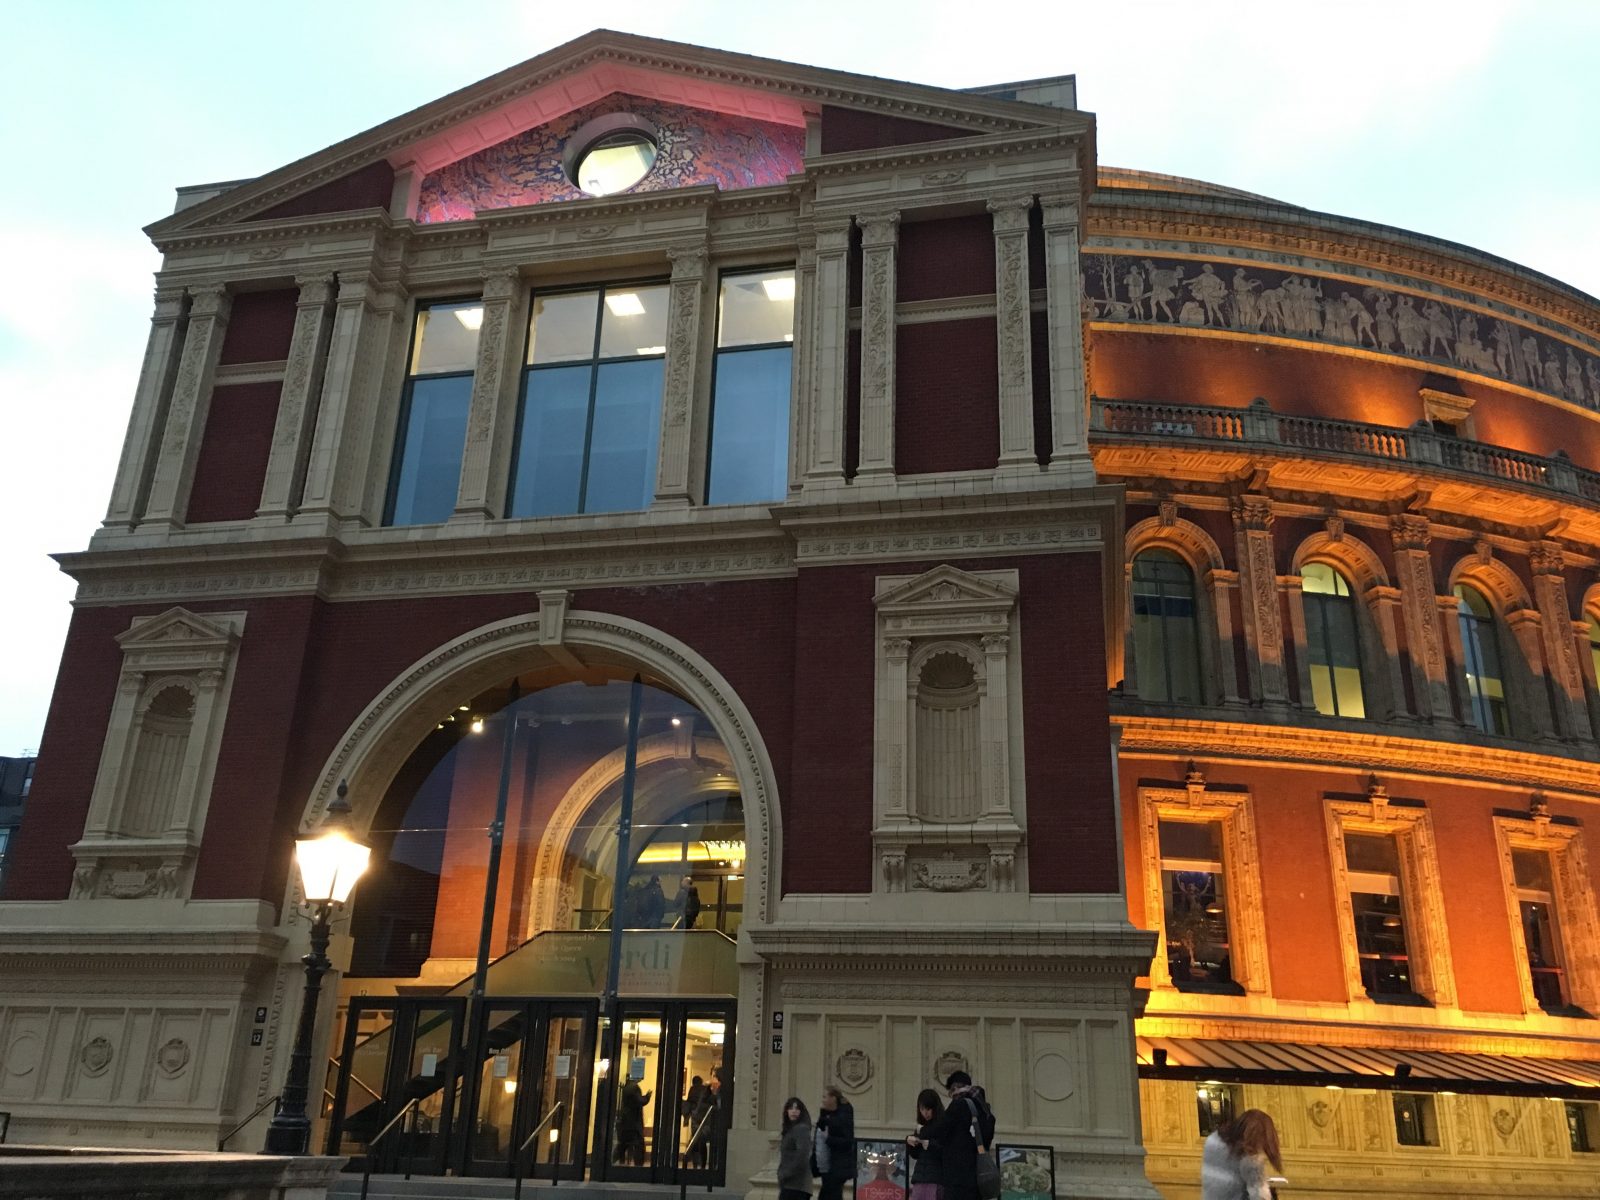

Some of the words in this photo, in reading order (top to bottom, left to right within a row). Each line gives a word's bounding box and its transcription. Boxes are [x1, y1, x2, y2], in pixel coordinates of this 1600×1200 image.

[1142, 240, 1160, 250] BY
[1188, 243, 1216, 255] HER
[253, 1034, 262, 1043] 12
[774, 1041, 784, 1050] 12
[864, 1187, 902, 1200] TOURS
